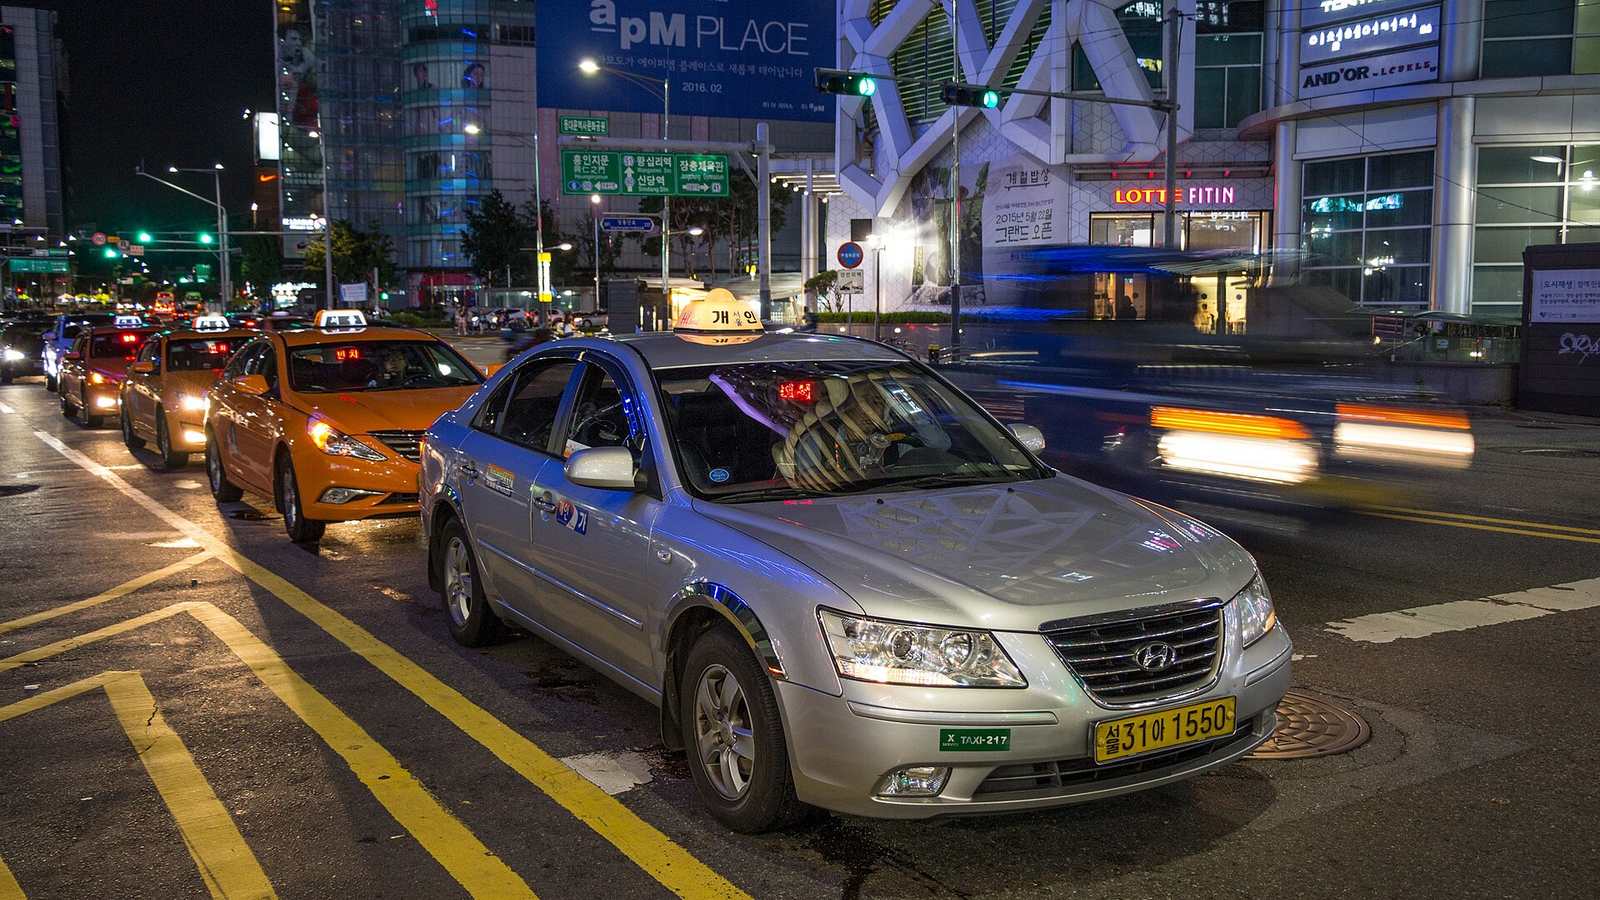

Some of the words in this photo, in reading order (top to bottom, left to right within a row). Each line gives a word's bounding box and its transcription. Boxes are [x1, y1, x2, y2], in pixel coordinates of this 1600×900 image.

[590, 0, 686, 50] apM
[696, 15, 809, 56] PLACE
[1303, 66, 1370, 89] AND'OR
[682, 81, 708, 94] 2016.
[710, 83, 722, 94] 02
[637, 156, 672, 168] 왕십리역
[679, 159, 725, 173] 장충체육관
[637, 175, 665, 187] 신당역
[1115, 188, 1184, 204] LOTTE
[1188, 186, 1235, 204] FITIN
[995, 224, 1029, 244] 그랜드
[1031, 221, 1053, 241] 오픈
[712, 310, 757, 325] 개인
[1105, 725, 1120, 755] 서울
[1121, 718, 1166, 751] 31아
[1171, 704, 1226, 740] 1550
[960, 735, 1008, 745] TAXI-217
